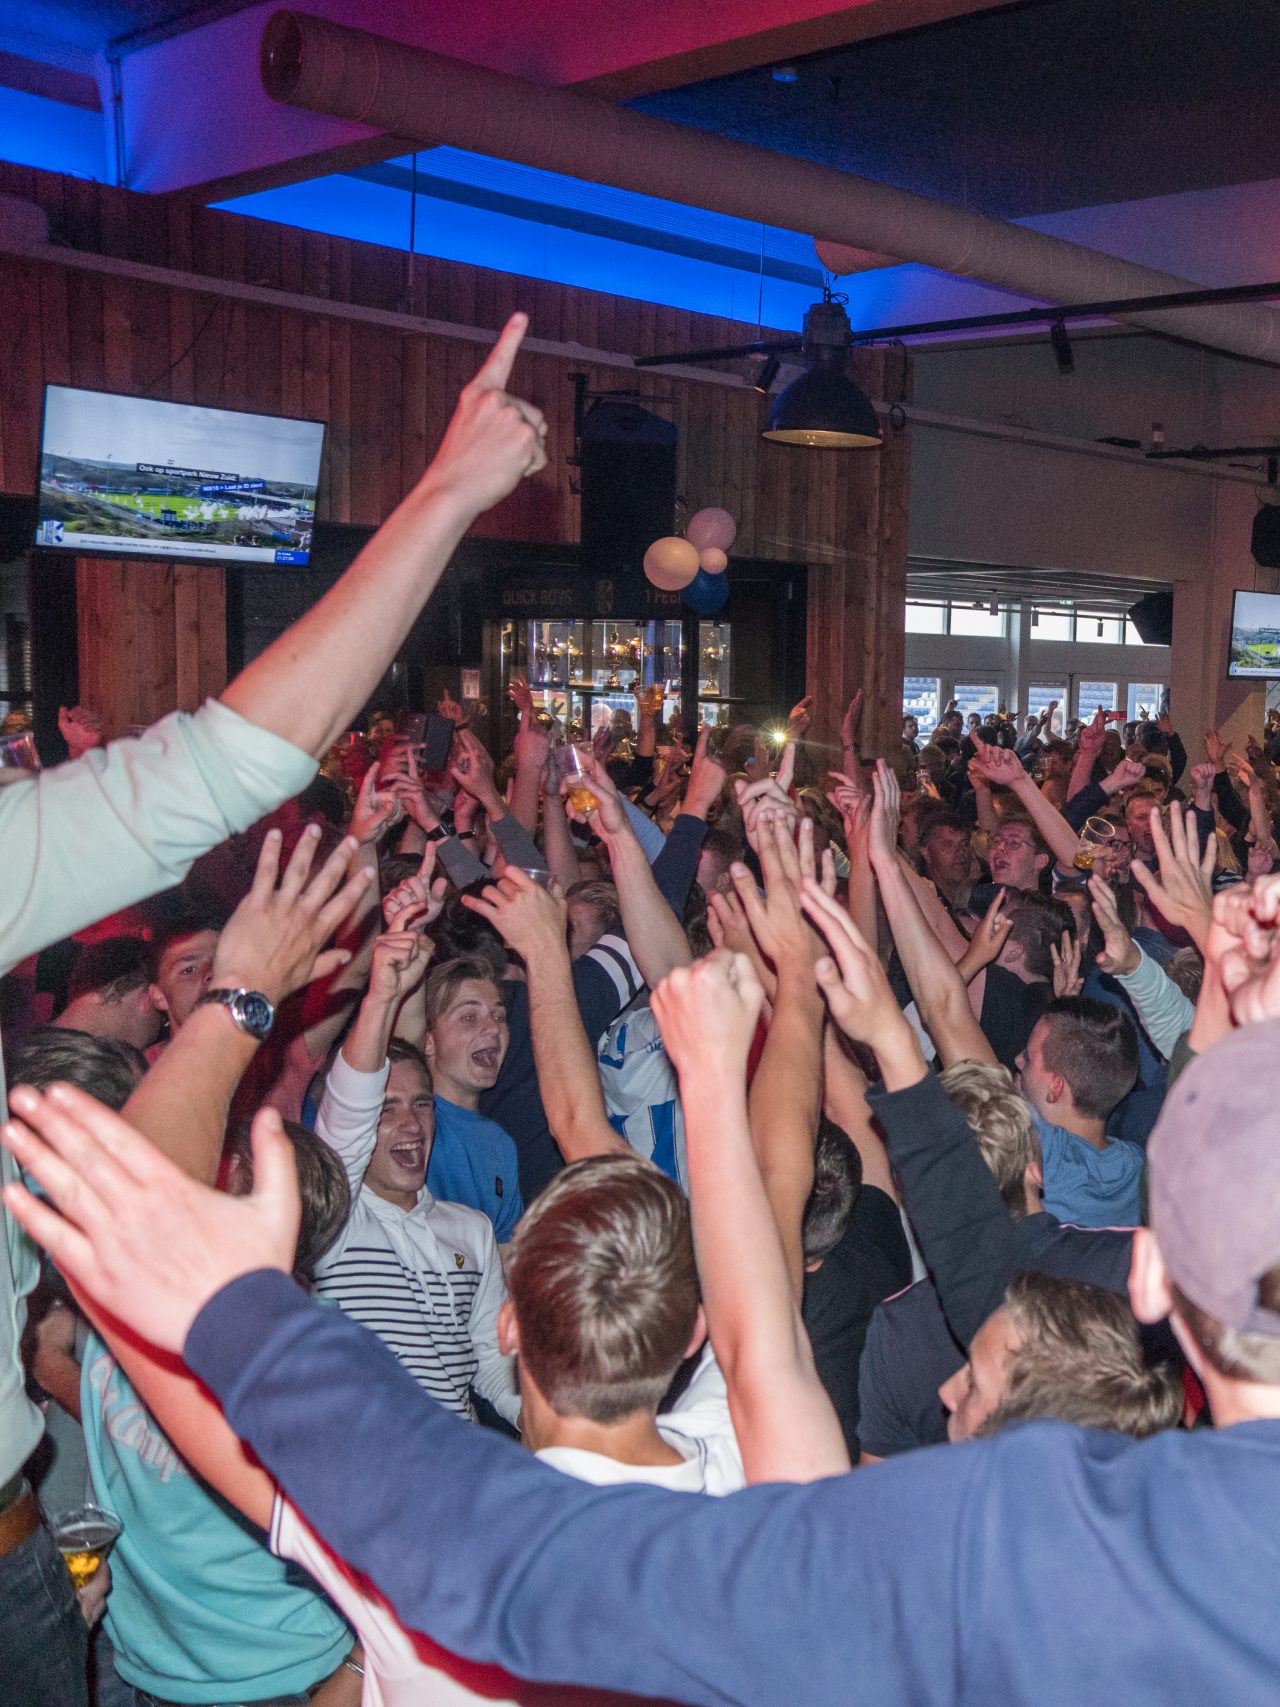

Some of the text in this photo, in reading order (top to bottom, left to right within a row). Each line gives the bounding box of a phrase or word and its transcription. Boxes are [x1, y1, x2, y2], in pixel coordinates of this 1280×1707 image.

[139, 464, 153, 472] Ook
[165, 468, 198, 478] sportpark
[199, 471, 219, 480] Nieuw
[503, 588, 573, 605] QUICK BOYS
